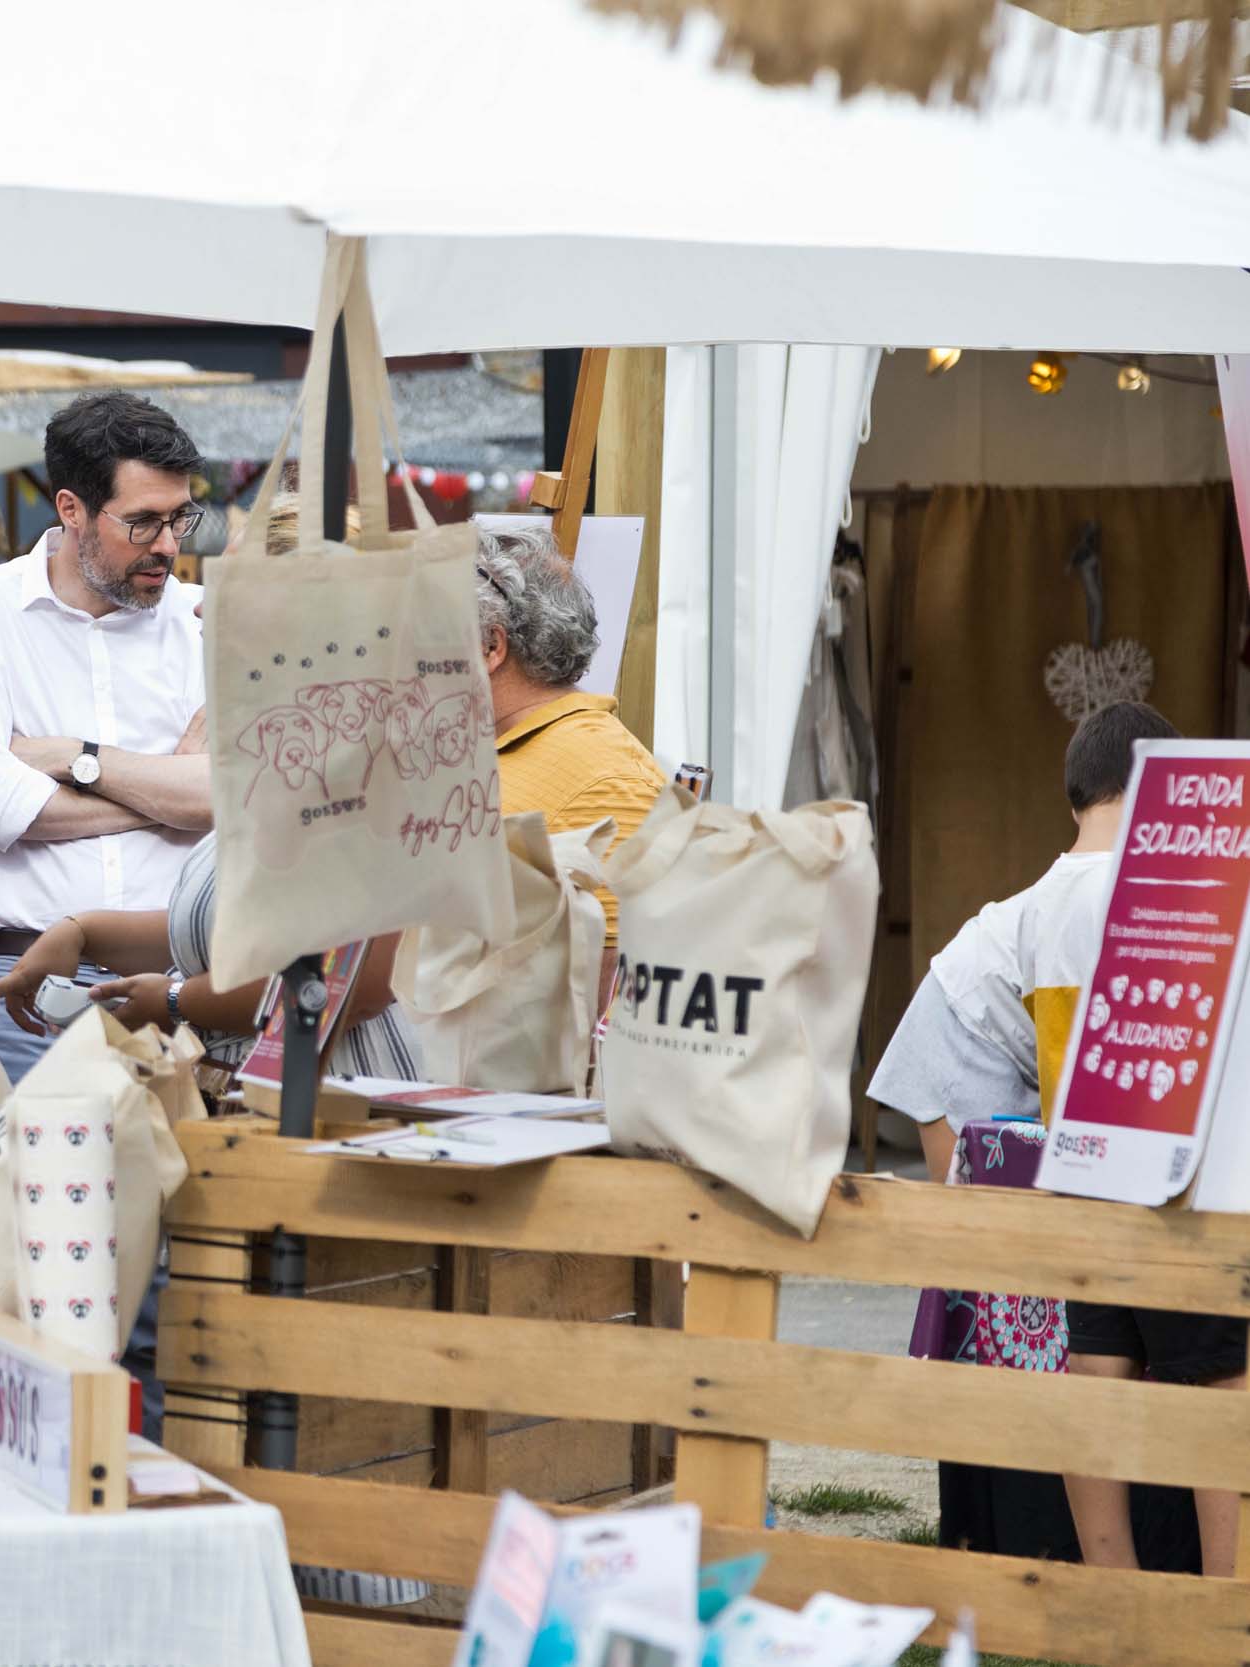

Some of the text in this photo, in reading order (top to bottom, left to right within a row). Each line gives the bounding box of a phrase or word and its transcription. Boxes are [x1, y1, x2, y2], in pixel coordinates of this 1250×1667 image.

[1166, 773, 1245, 808] VENDA
[1129, 812, 1250, 859] SOLIDÀRIA
[1103, 1021, 1193, 1051] AJUDA'NS!
